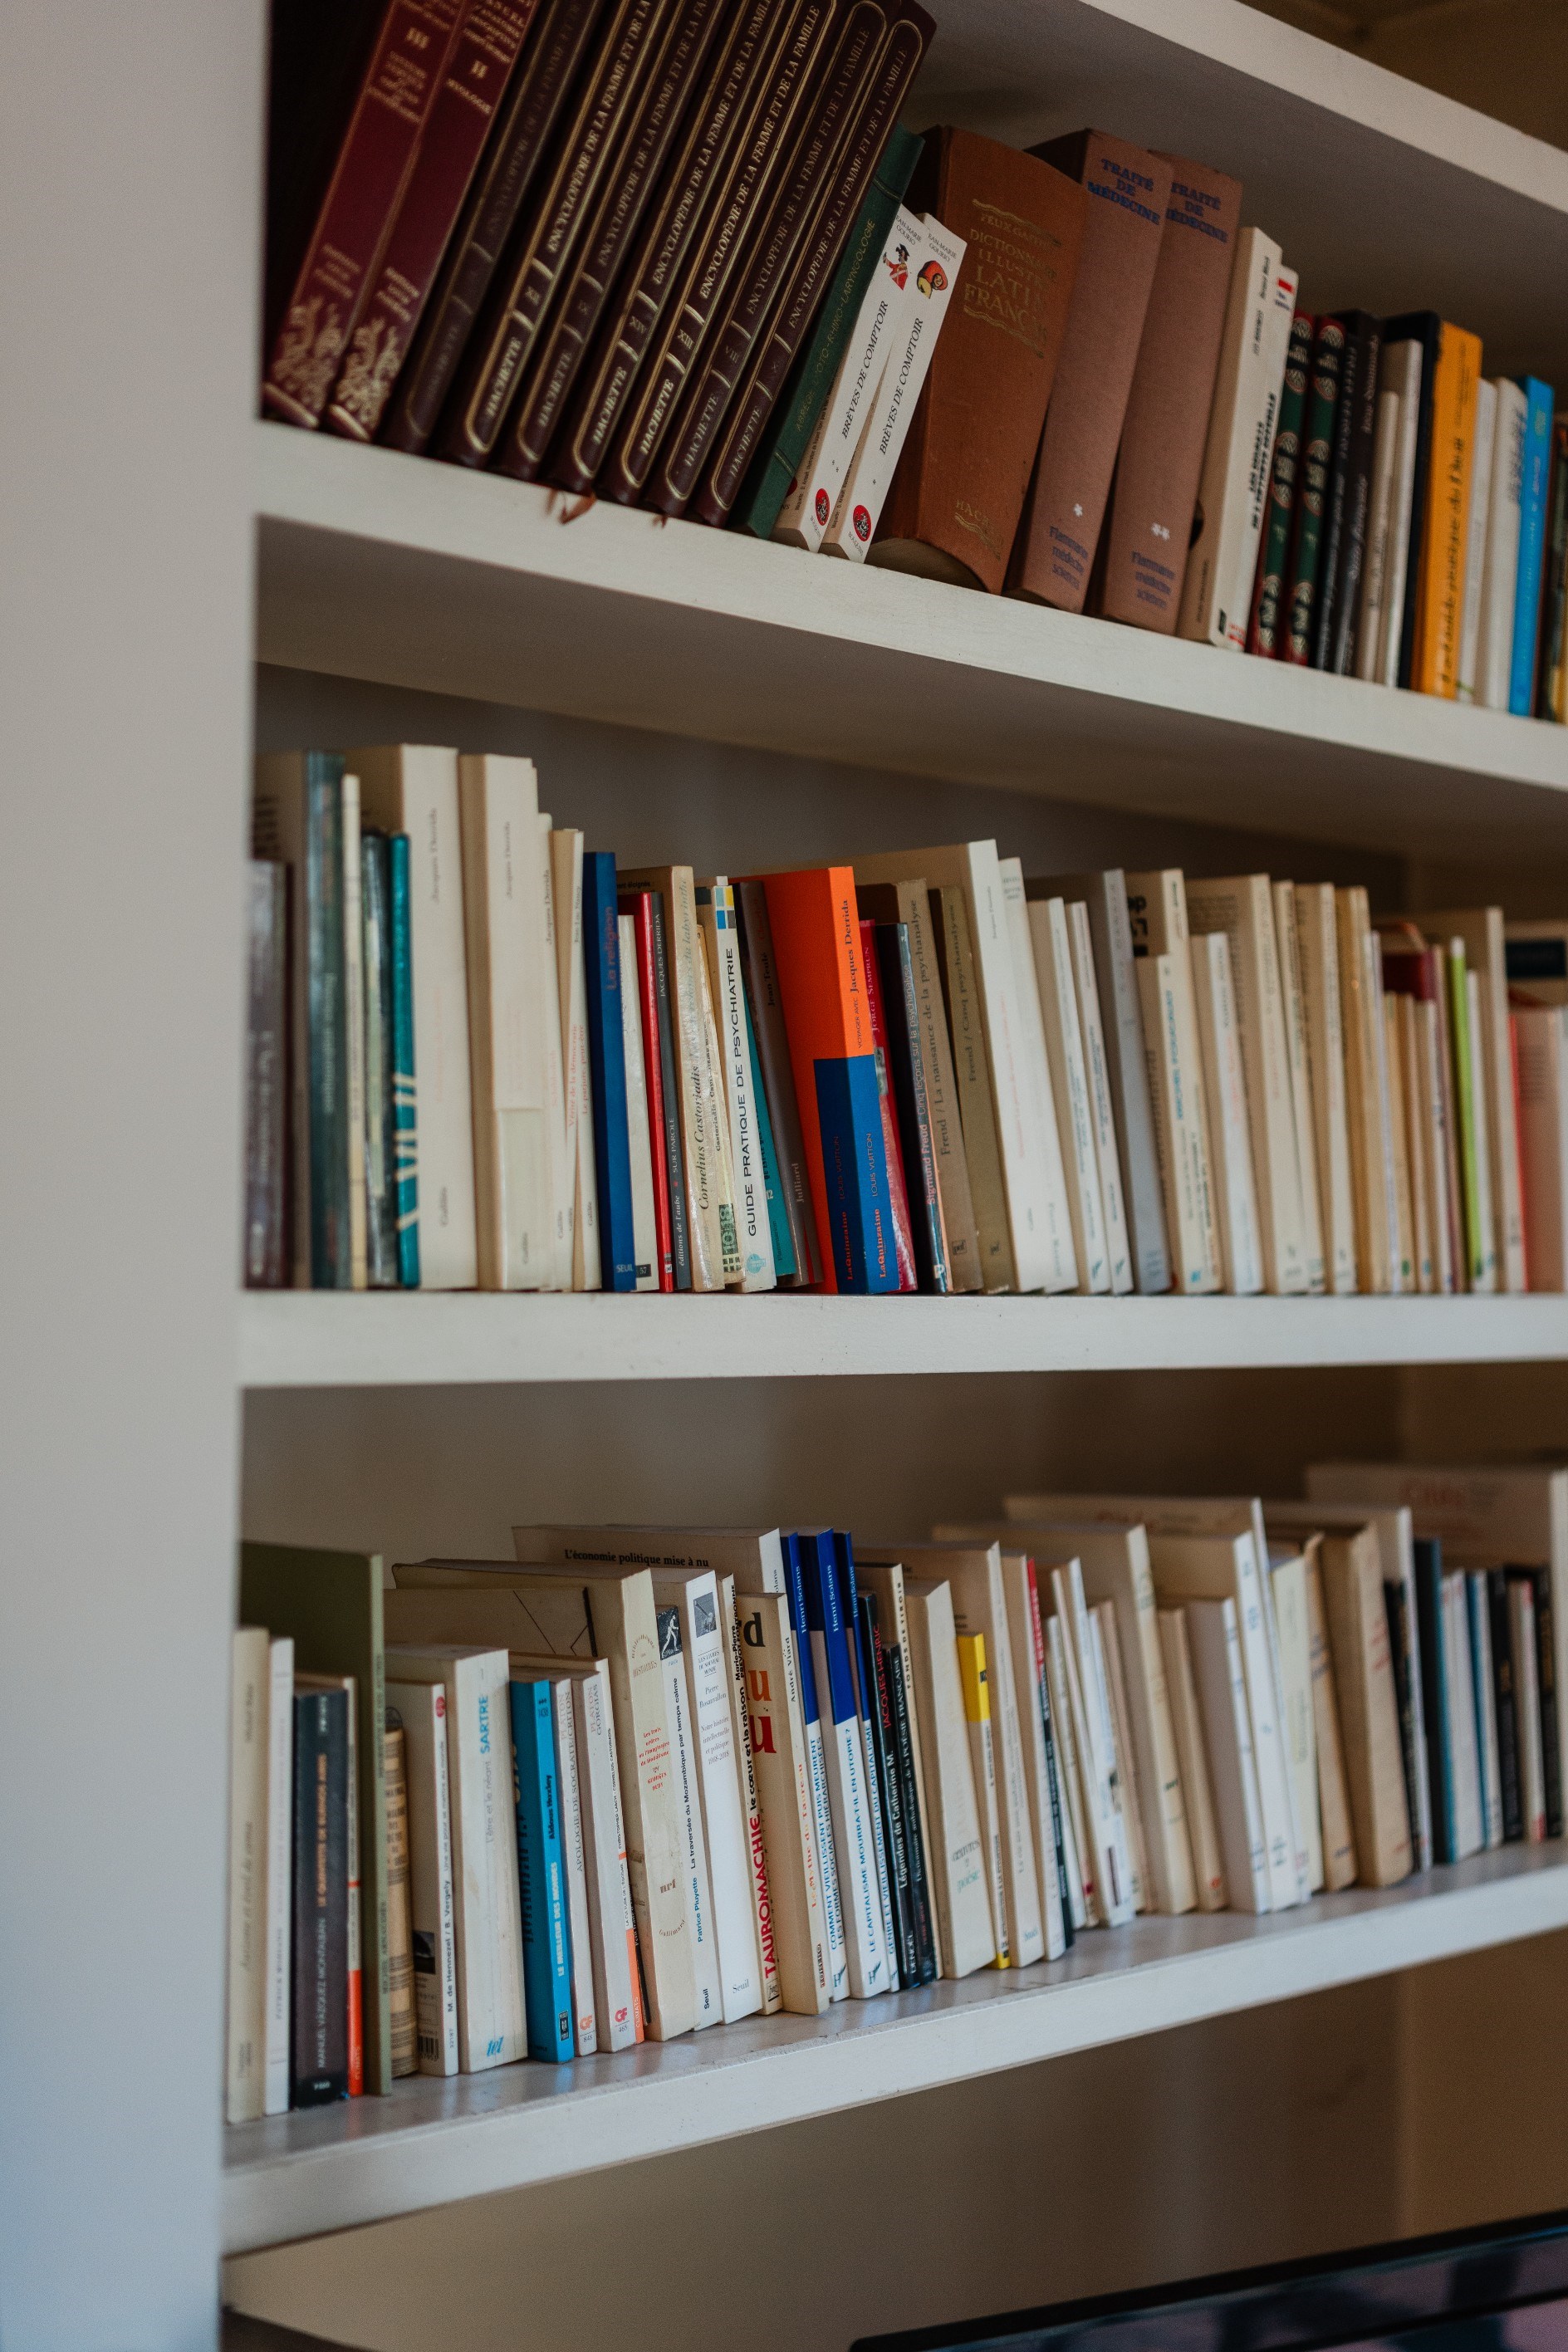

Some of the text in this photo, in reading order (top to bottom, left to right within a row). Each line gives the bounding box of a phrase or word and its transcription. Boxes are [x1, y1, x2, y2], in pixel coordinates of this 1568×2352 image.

[698, 5, 821, 300] ENCYCLOPÉDIE DE LA FEMME ET DE LA FAMILLE
[1100, 159, 1154, 192] TRAITÉ
[1116, 179, 1135, 196] DE
[1087, 180, 1161, 225] MÉDECINE
[896, 215, 922, 243] EAN-MARIE
[896, 225, 916, 245] GOURIO
[841, 300, 889, 439] BRÈVES DE COMPTOIR
[878, 317, 924, 455] BRÈVES DE COMPTOIR
[729, 405, 763, 478] HACHETTE
[543, 869, 555, 945] Jacques Derrida
[840, 899, 855, 944] Derrida
[604, 906, 622, 989] La religion
[655, 914, 667, 996] JACQUES DERRIDA
[909, 899, 930, 982] psychanalyse
[761, 952, 777, 1007] Jean Teulé
[846, 949, 860, 993] Jacques
[860, 946, 883, 1032] JORGE SEMPRUN
[920, 988, 932, 999] la
[923, 1004, 934, 1019] de
[855, 1016, 865, 1048] VOYAGER
[925, 1024, 943, 1083] naissance
[726, 948, 758, 1236] GUIDE PRATIQUE DE PSYCHIATRIE
[902, 964, 938, 1203] Sigmund Freud Cinq leçons sur la psychanalyse
[933, 1088, 945, 1104] La
[669, 1117, 678, 1151] PAROLE
[688, 1066, 712, 1210] Cornelius Castoriadis
[937, 1119, 952, 1155] Freud
[792, 1162, 806, 1203] Julliard
[867, 1133, 880, 1197] LOUIS VUITTON
[674, 1194, 686, 1267] éditions de l'aube
[874, 1208, 888, 1278] LaQuinzaine
[616, 1263, 634, 1273] SEUIL
[639, 1267, 648, 1275] 57
[565, 1550, 616, 1561] L'économie
[619, 1552, 661, 1566] politique
[664, 1555, 685, 1565] mise
[688, 1556, 693, 1566] à
[826, 1565, 840, 1630] Henri Solans
[897, 1581, 913, 1688] FONDS DE TIROIR
[705, 1683, 719, 1694] Pierre
[784, 1637, 797, 1702] André Viard
[872, 1622, 892, 1727] JACQUES HENRIC
[586, 1687, 599, 1732] PLATON
[591, 1683, 605, 1734] GORGIAS
[699, 1693, 727, 1708] Rosanvallon
[478, 1695, 492, 1753] SARTRE
[701, 1717, 729, 1732] Notre histoire
[703, 1727, 730, 1743] intellectuelle
[708, 1751, 730, 1766] 1968-2018
[710, 1740, 729, 1754] politique
[846, 1736, 857, 1775] UTOPIE
[671, 1677, 698, 1868] La traversée du Mozambique par temps calme
[851, 1777, 859, 1792] EN
[483, 1760, 496, 1842] l'être et le néant
[544, 1774, 556, 1839] Aldous Huxley
[887, 1750, 910, 1888] Légendes de Catherine M.
[738, 1686, 779, 1978] TAUROMACHIE le cœur et la raison
[811, 1738, 837, 1950] COMMENT VIEILLISSENT PUIS MEURENT
[853, 1795, 867, 1864] MOURRA-T-IL
[952, 1839, 980, 1862] œuvres
[444, 1880, 453, 1915] Vergely
[659, 1879, 676, 1894] nrf
[861, 1867, 875, 1936] CAPITALISME
[957, 1869, 980, 1893] poésie
[445, 1918, 453, 1928] B.
[550, 1861, 566, 1977] LE MEILLEUR DES MONDES
[659, 1919, 685, 1938] Gallimard
[692, 1876, 705, 1942] Patrice Pluyette
[446, 1937, 454, 1980] Hennezel
[869, 1938, 877, 1952] LE
[448, 1983, 454, 1996] de
[448, 1999, 455, 2011] M.
[703, 1987, 711, 2008] Seuil
[733, 1979, 750, 1993] Seuil
[486, 2036, 503, 2058] tel
